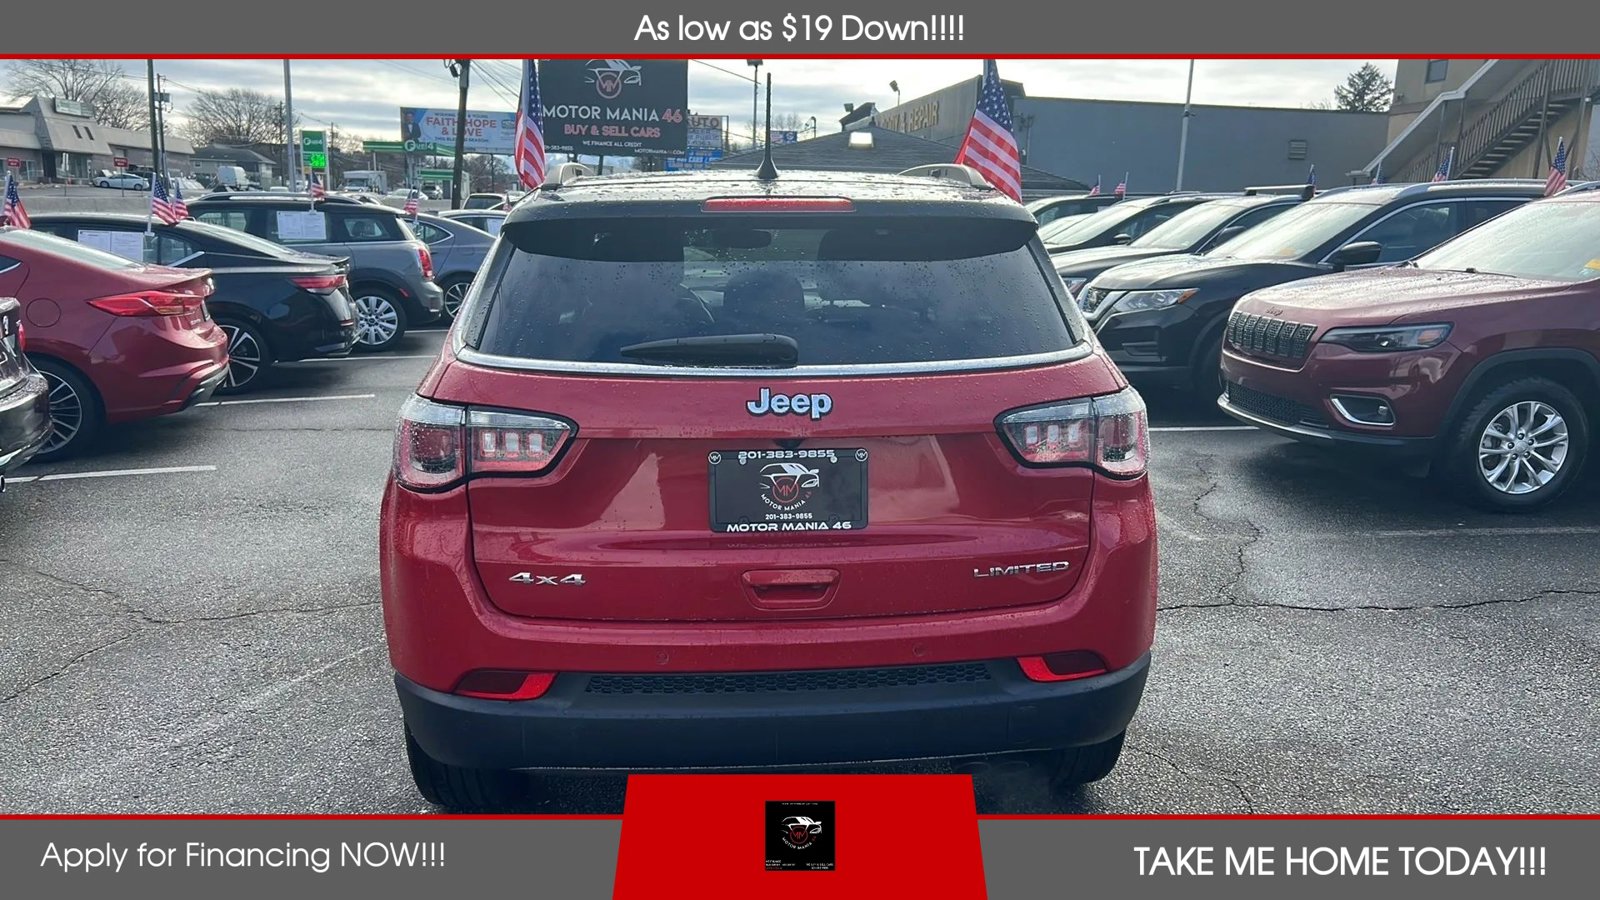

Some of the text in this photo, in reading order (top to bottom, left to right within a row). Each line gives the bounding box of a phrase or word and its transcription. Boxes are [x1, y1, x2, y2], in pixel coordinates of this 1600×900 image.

[543, 105, 683, 123] MOTOR MANIA 46
[909, 100, 940, 133] REPAIR
[687, 116, 720, 128] UTO
[452, 128, 483, 137] LVE
[564, 124, 661, 138] BUY & SELL CARS
[746, 387, 833, 420] Jeep
[738, 450, 836, 460] 201-383-9855
[760, 493, 783, 511] MOTOR
[784, 499, 806, 511] MANIA
[765, 512, 813, 520] 201-383-9855
[726, 521, 853, 533] MOTOR MANIA 46
[973, 561, 1070, 578] LIMITED
[508, 572, 587, 586] 4x4
